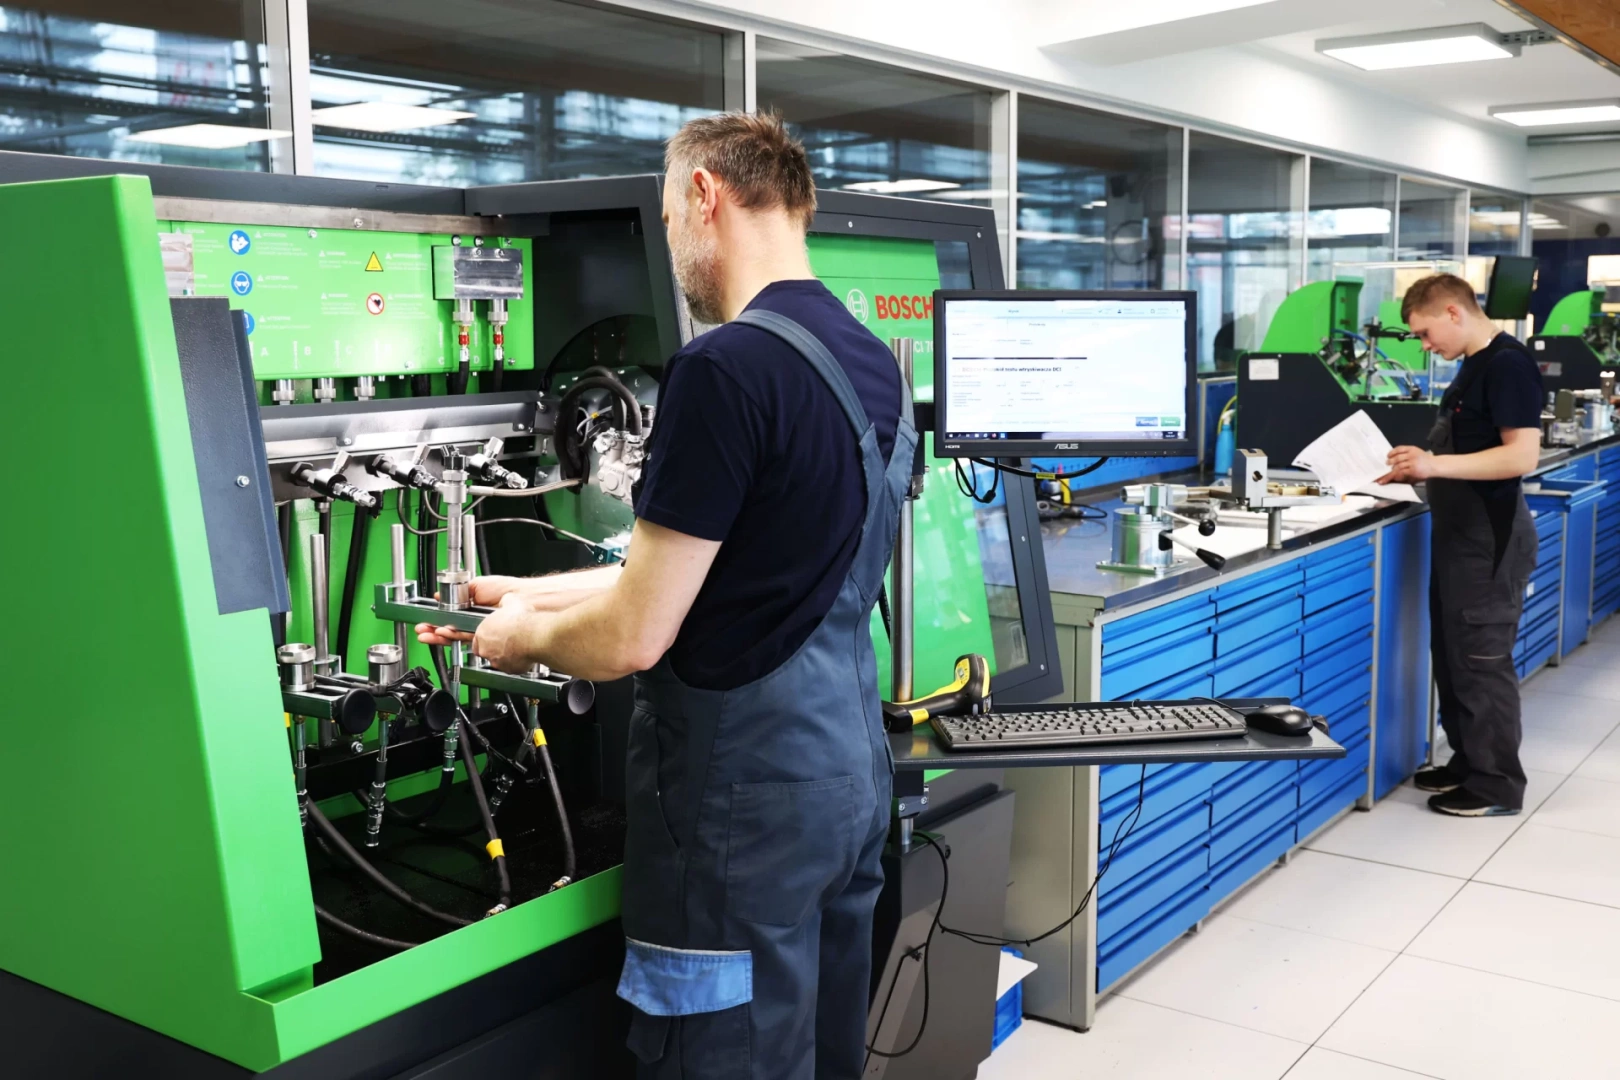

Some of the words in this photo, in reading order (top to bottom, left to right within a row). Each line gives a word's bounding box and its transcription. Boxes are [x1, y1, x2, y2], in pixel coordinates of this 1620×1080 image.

[875, 295, 933, 319] BOSCH
[260, 347, 269, 356] A
[303, 346, 312, 356] B
[473, 355, 480, 365] D
